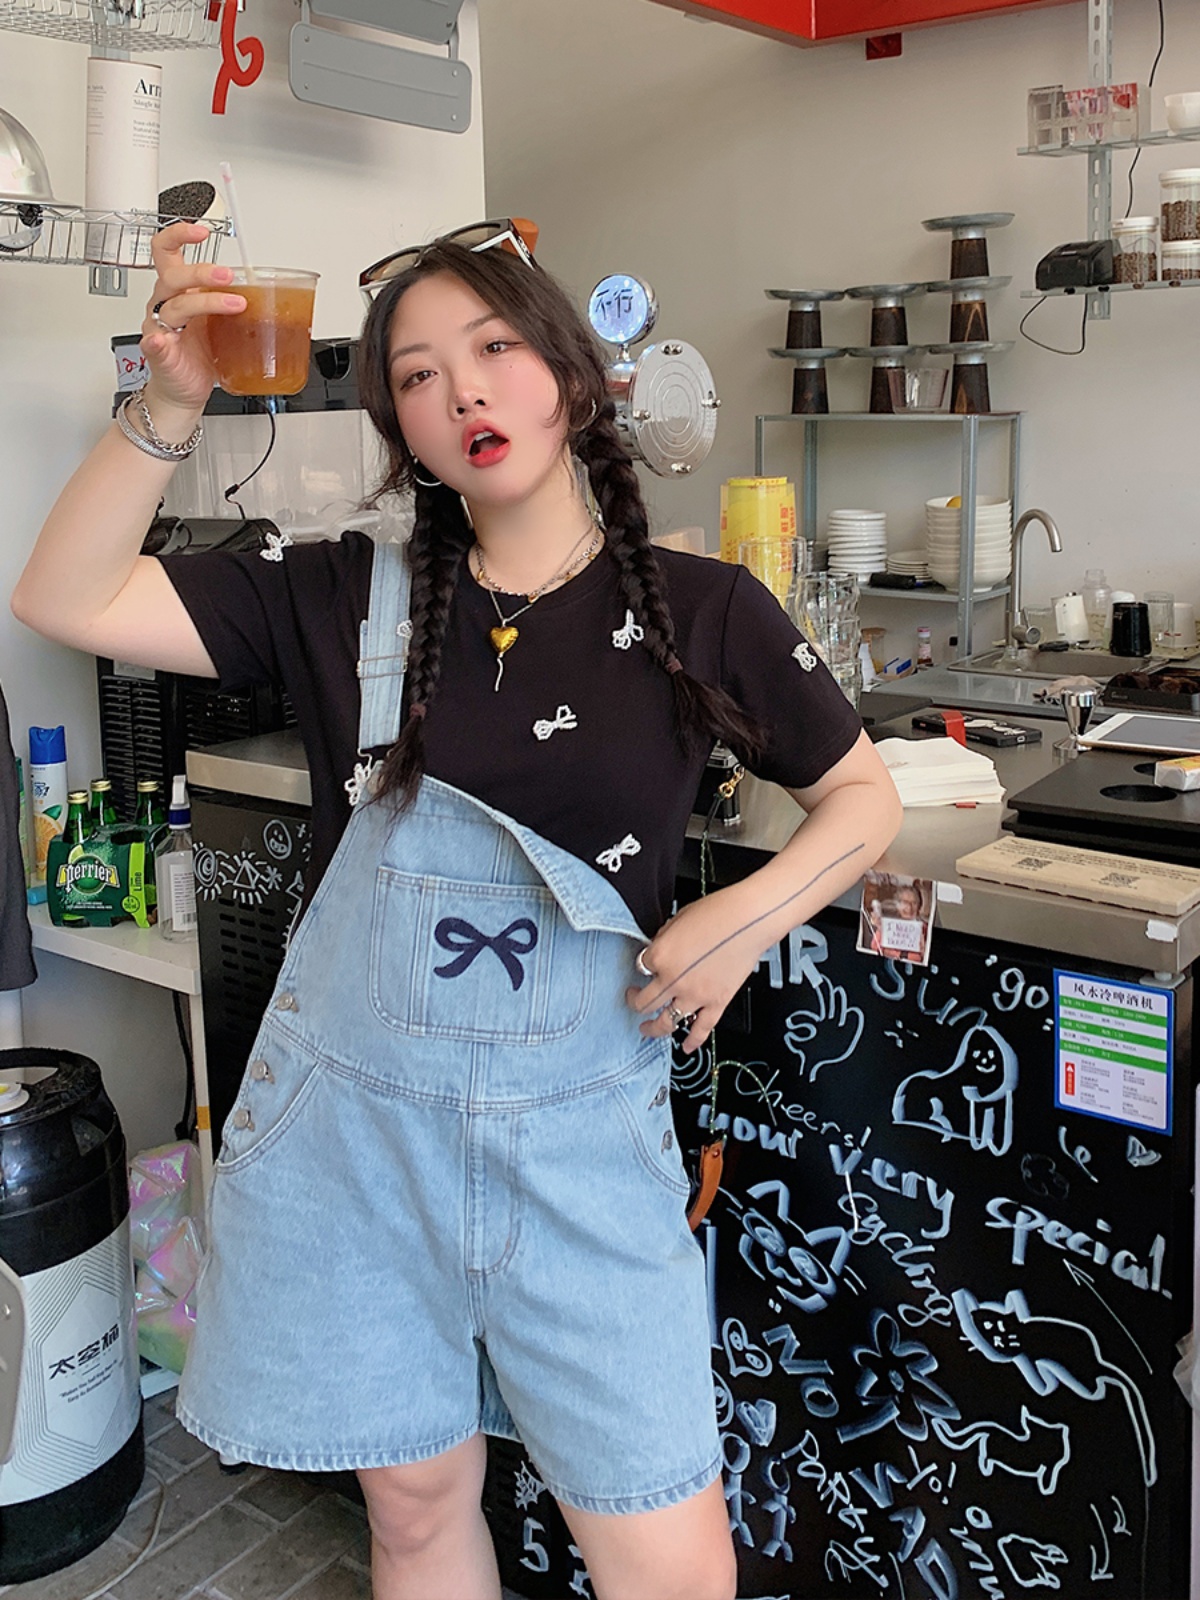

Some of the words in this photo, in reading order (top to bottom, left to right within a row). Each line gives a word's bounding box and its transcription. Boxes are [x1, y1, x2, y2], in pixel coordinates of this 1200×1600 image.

[595, 288, 634, 321] 不行
[133, 871, 143, 892] Lime
[1074, 982, 1154, 1011] 风水冷啤酒机
[906, 1444, 957, 1505] Yo!
